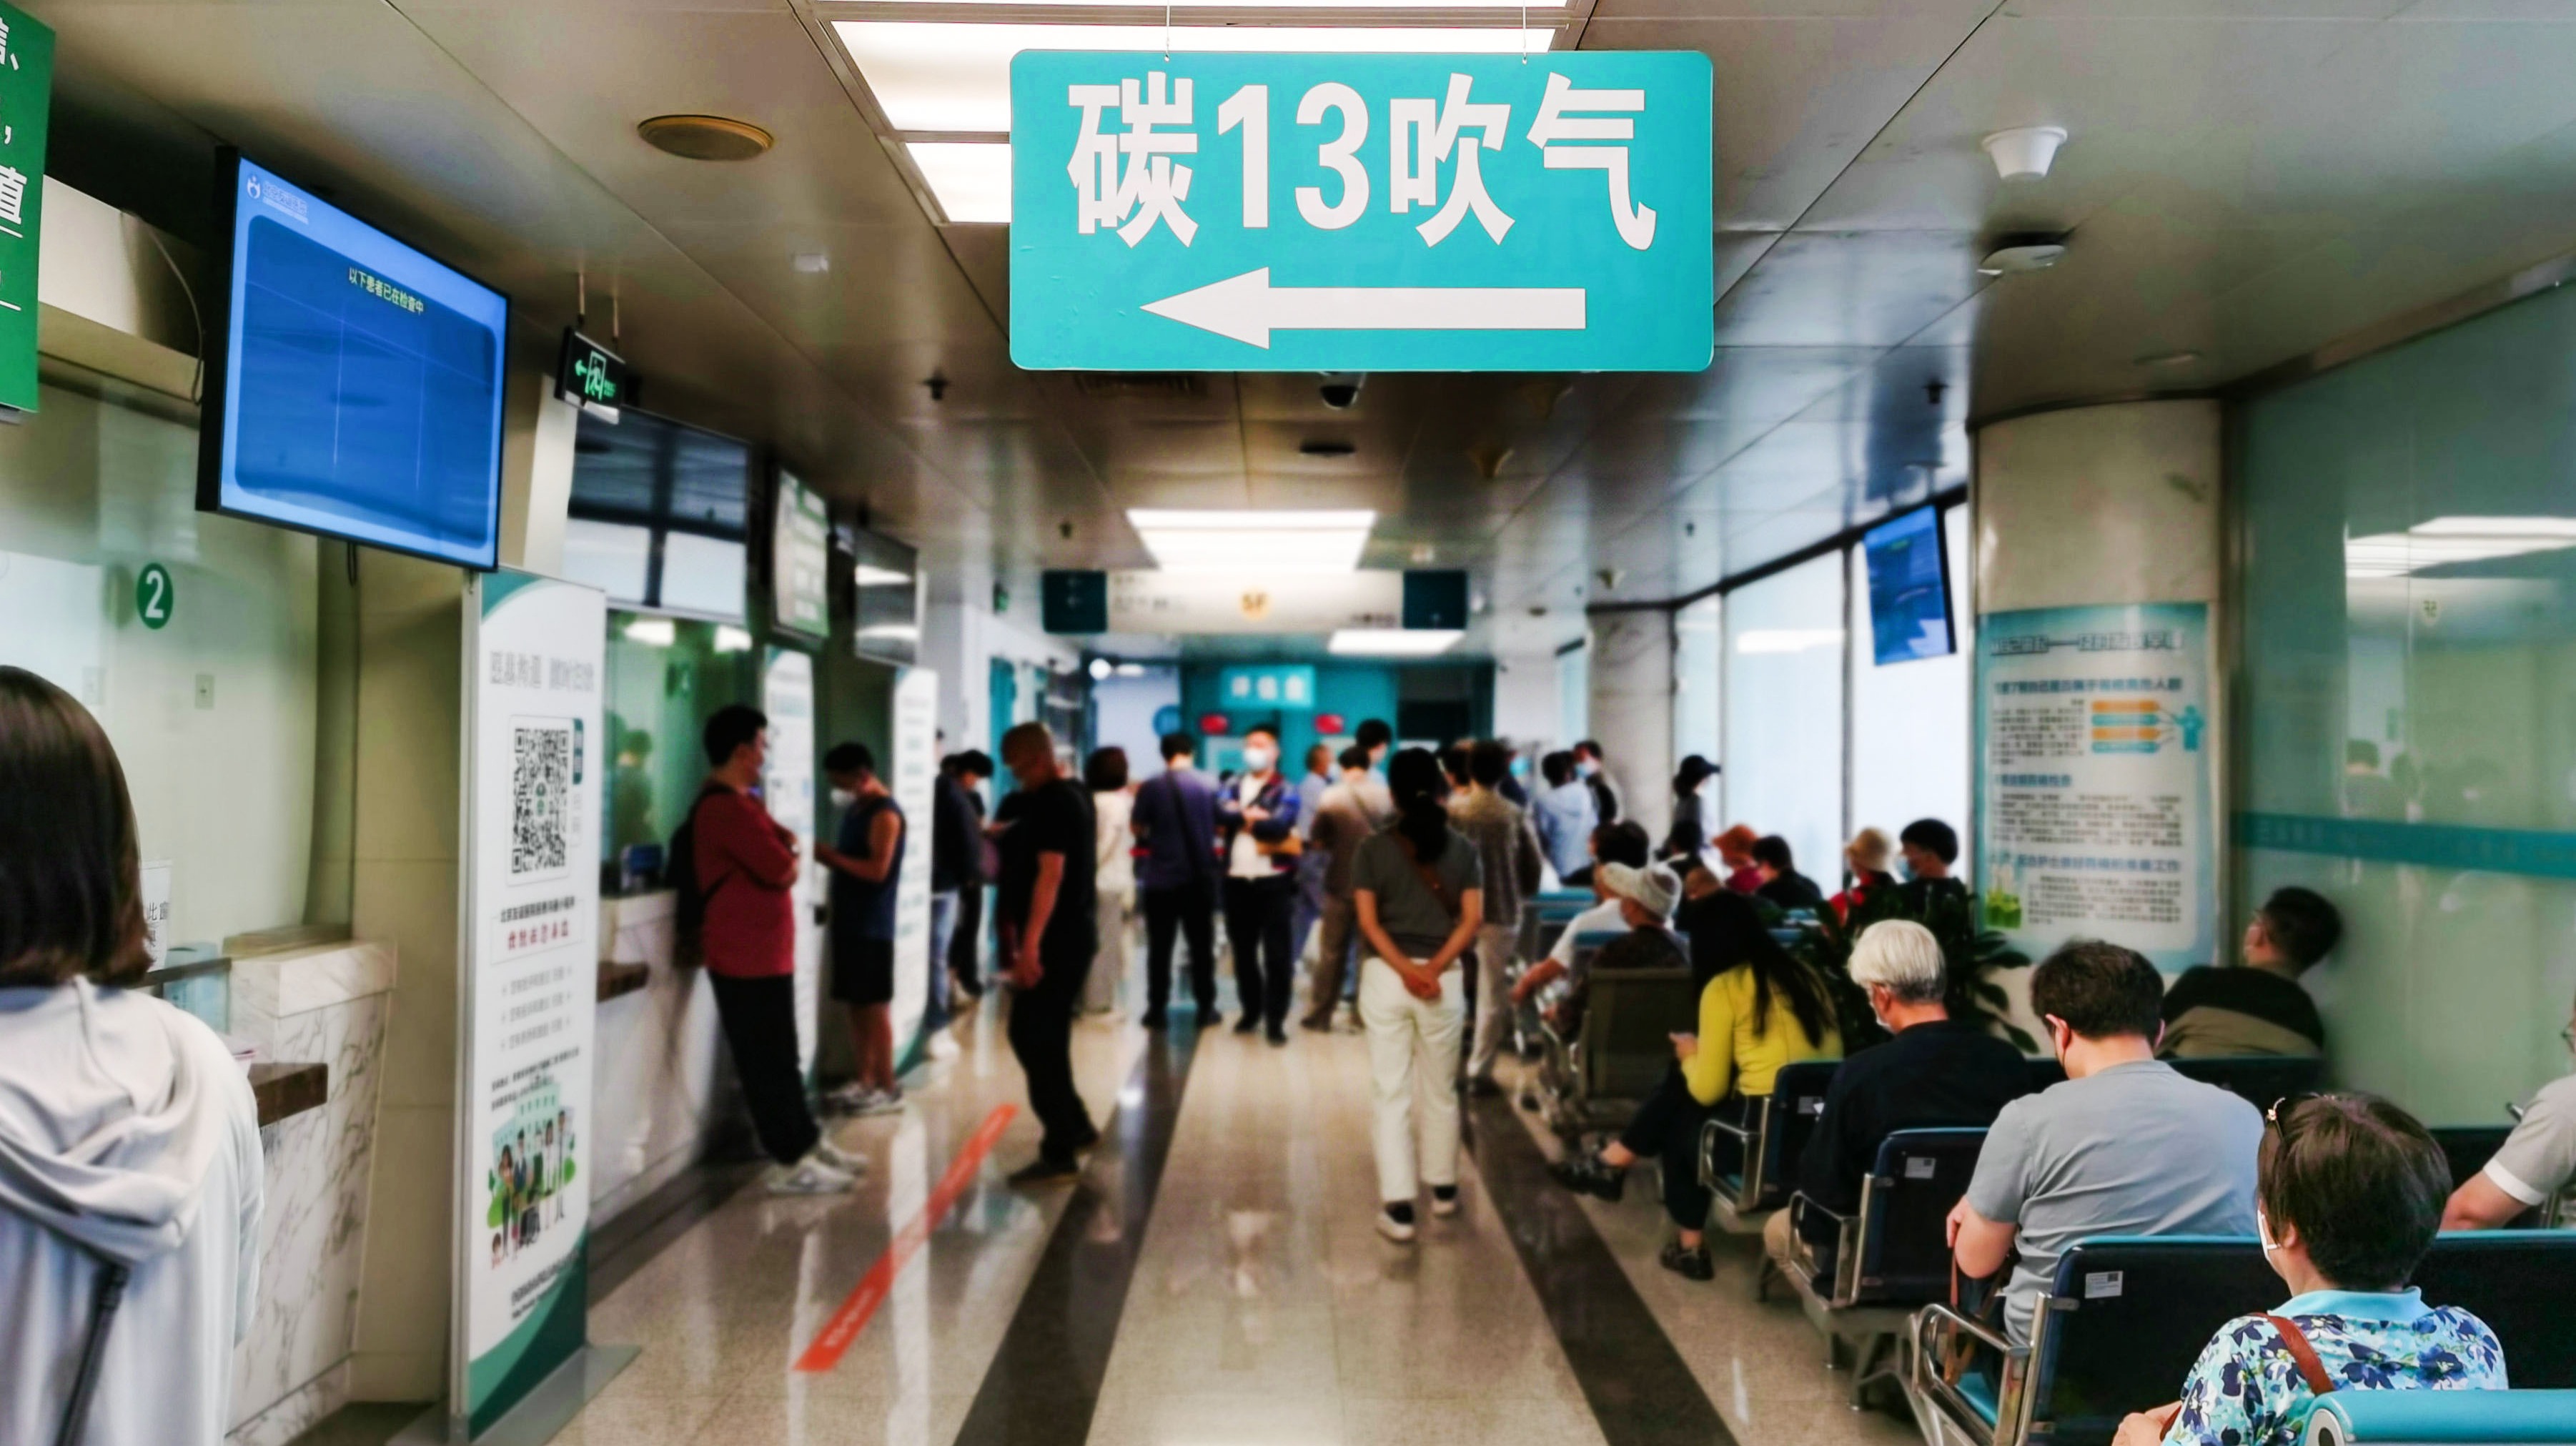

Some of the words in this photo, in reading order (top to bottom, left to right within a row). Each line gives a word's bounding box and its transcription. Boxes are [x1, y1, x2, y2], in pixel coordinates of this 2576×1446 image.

[1067, 71, 1657, 251] 碳13吹气
[349, 267, 424, 315] 以下患者已在检查中
[145, 570, 164, 618] 2
